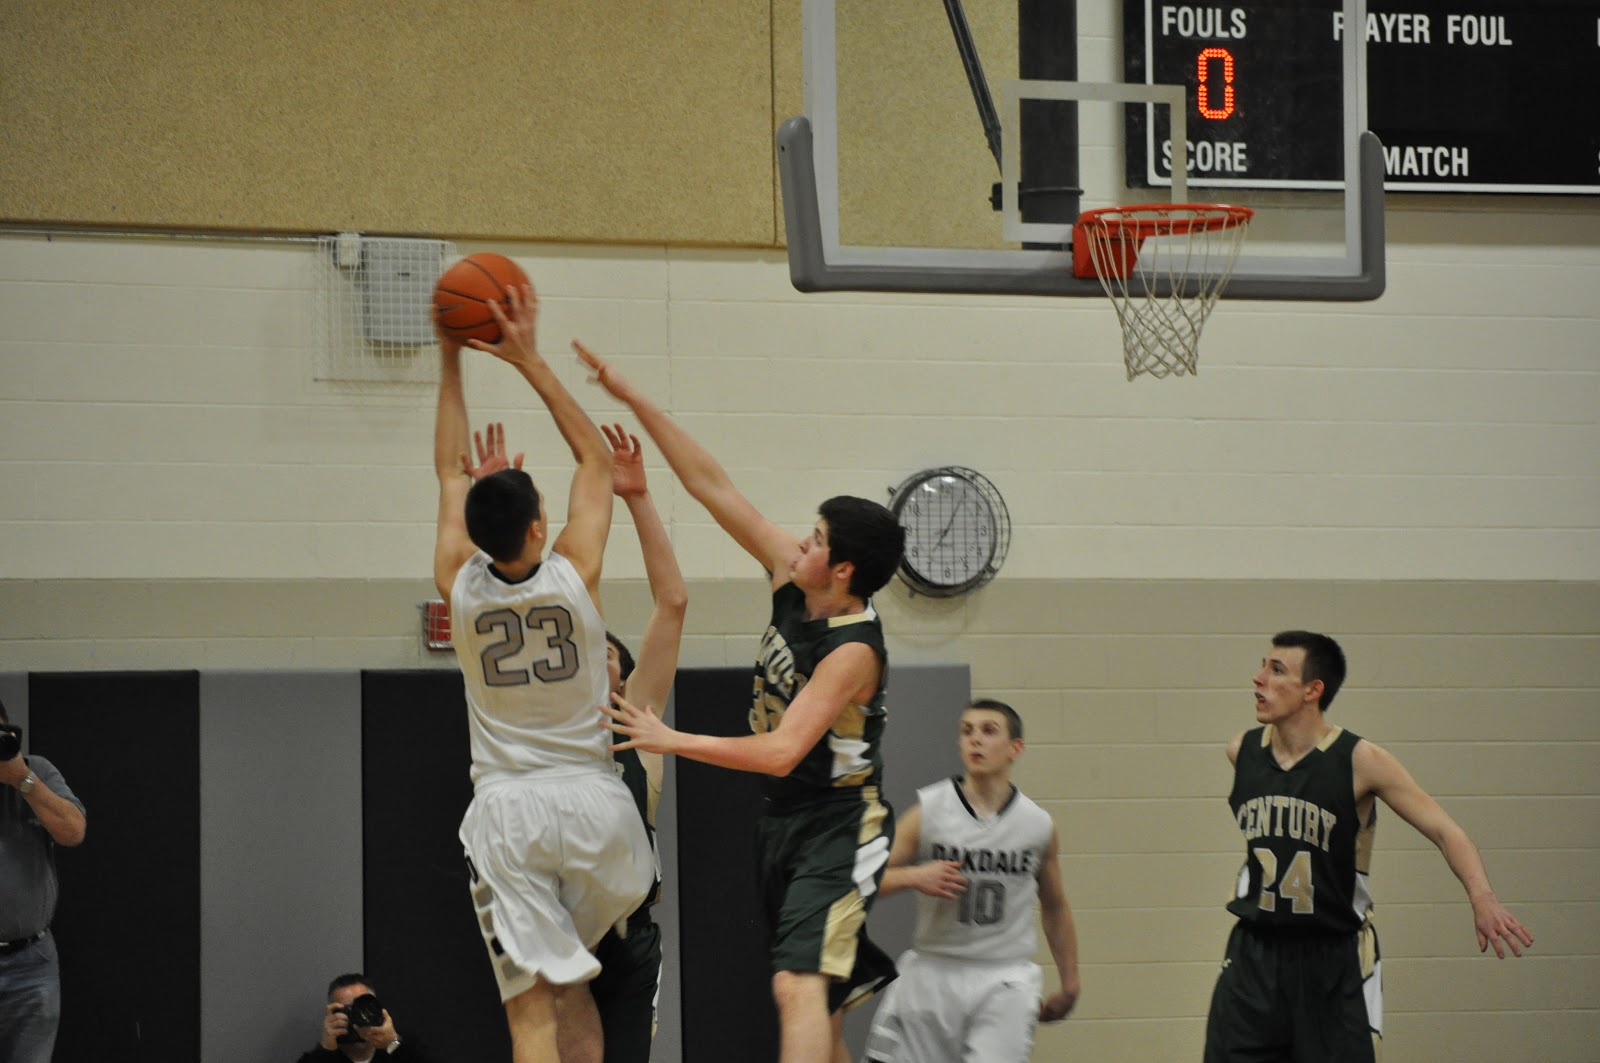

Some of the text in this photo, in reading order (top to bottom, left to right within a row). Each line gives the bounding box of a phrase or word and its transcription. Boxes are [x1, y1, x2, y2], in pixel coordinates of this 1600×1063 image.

[1162, 6, 1246, 39] FOULS
[1333, 11, 1513, 46] PAYER FOUL
[1198, 48, 1234, 119] 0
[1162, 140, 1247, 172] SCORE
[1382, 145, 1469, 177] MATCH
[475, 604, 580, 687] 23
[1236, 795, 1338, 852] CENTURY
[958, 878, 1007, 926] 10
[1253, 847, 1315, 914] 24
